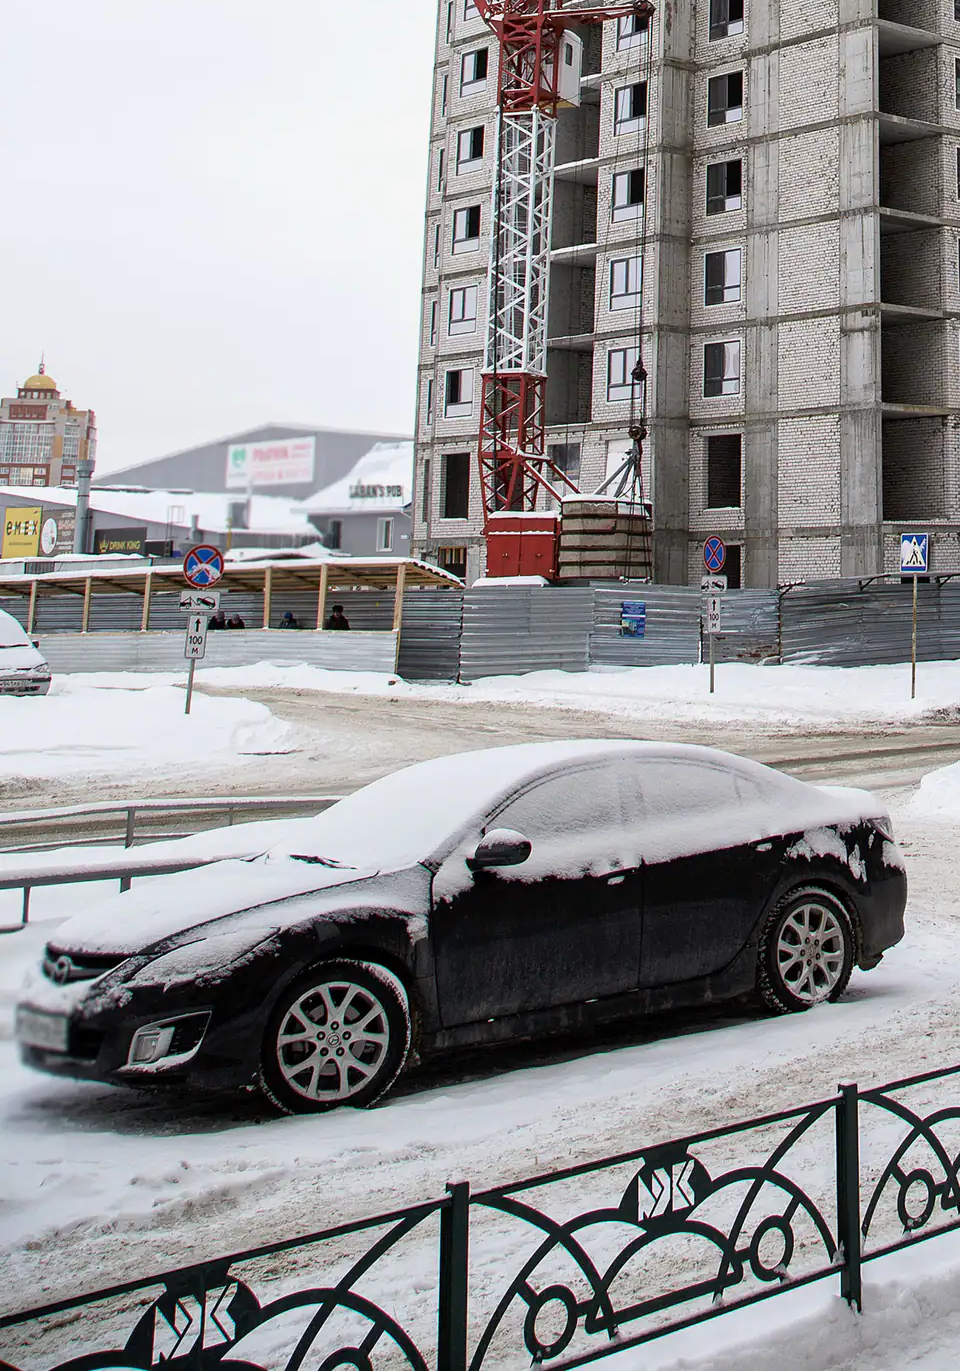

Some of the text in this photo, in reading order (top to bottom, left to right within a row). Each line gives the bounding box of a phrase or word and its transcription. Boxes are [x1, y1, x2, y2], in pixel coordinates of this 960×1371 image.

[386, 485, 402, 497] PUB
[110, 540, 141, 550] DRINK KING
[709, 613, 720, 621] 100
[189, 635, 203, 645] 100
